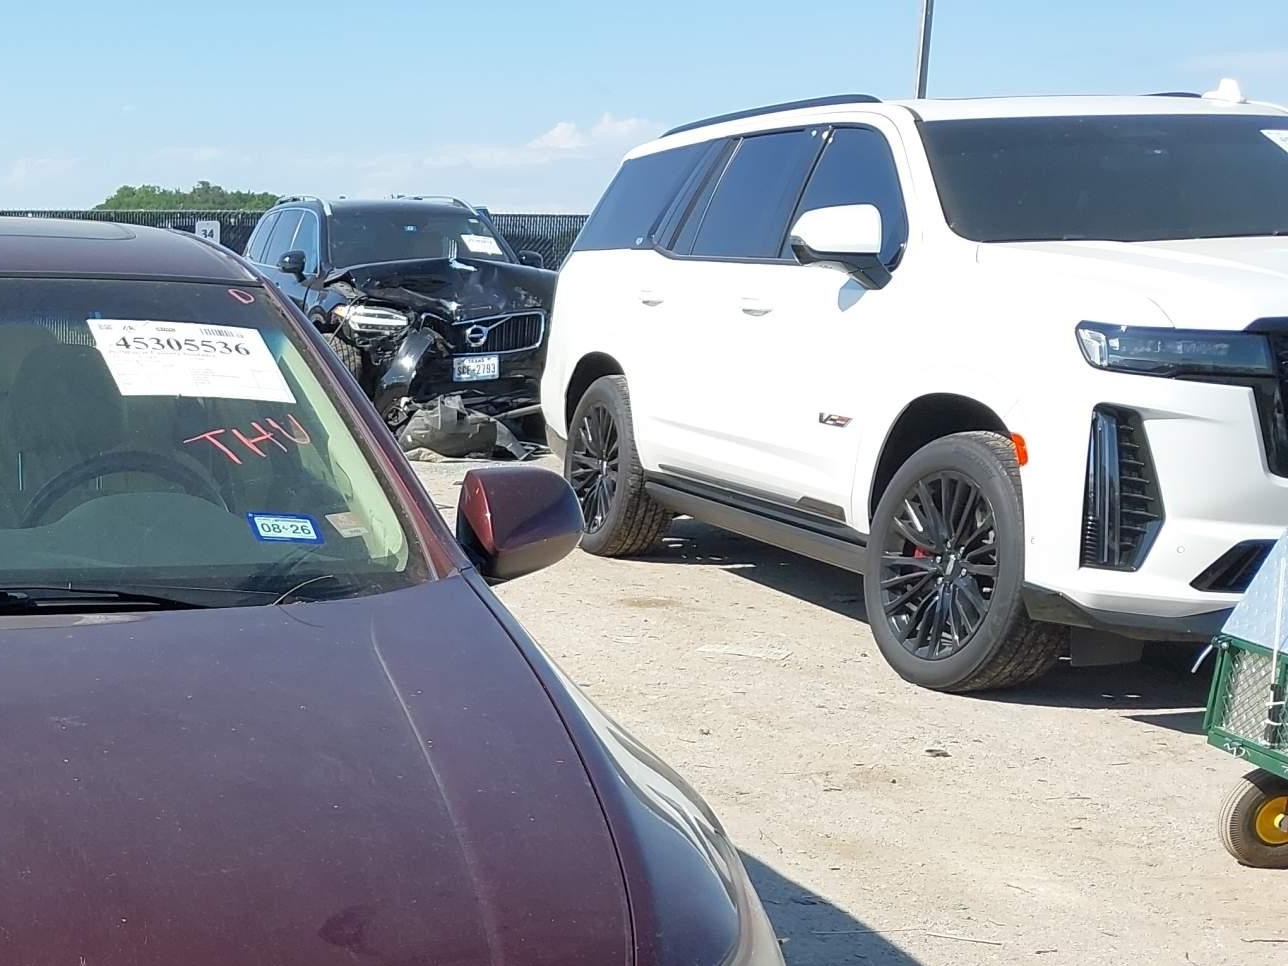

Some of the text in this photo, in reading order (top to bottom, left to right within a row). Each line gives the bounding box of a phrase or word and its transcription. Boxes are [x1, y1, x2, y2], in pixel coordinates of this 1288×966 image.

[201, 229, 214, 238] 34
[115, 335, 251, 356] 45305536
[183, 413, 311, 465] THU
